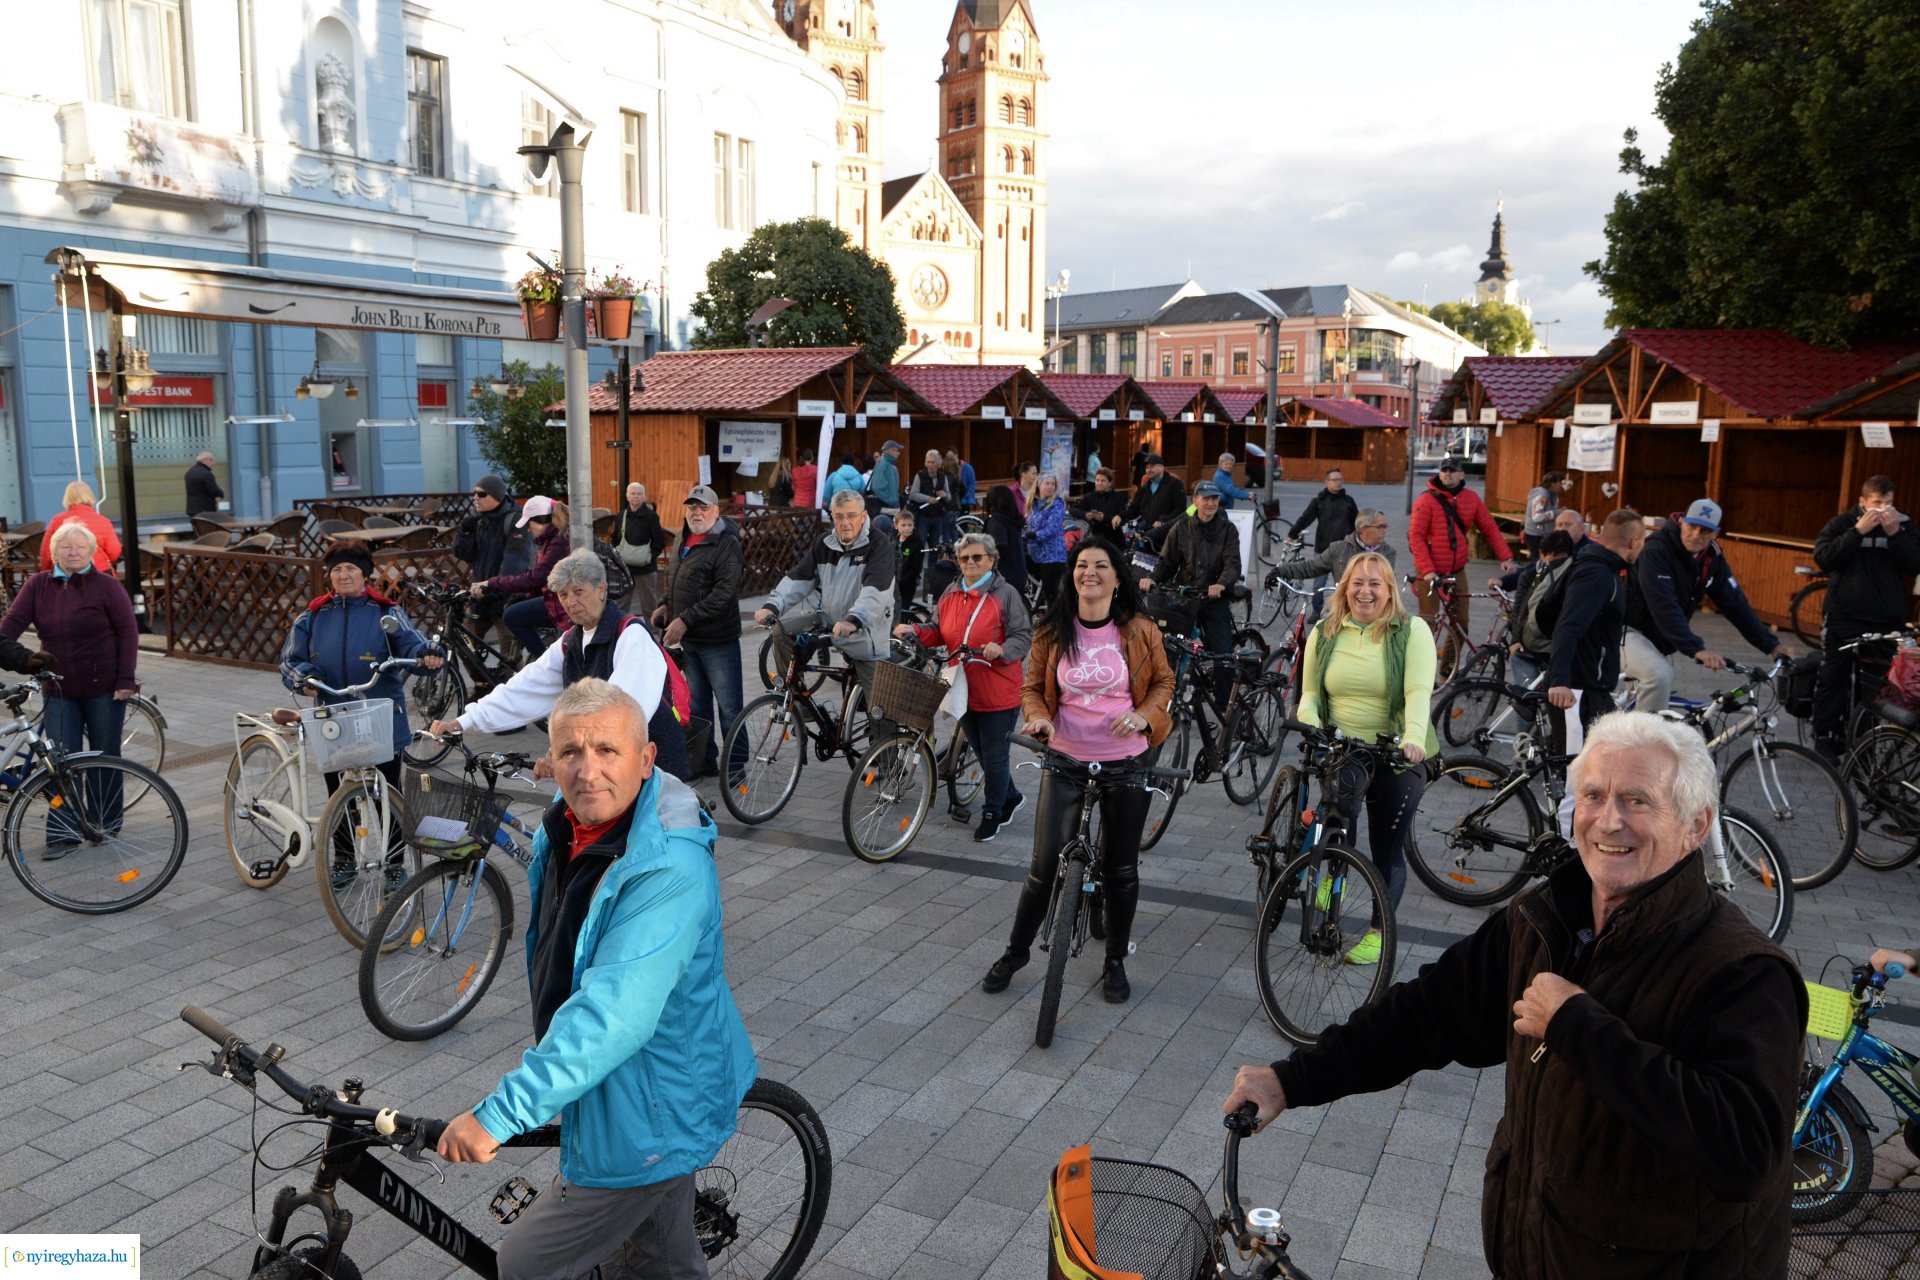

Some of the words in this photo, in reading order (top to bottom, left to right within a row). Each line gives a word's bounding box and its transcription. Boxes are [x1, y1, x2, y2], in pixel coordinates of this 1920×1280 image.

[351, 305, 386, 326] JOHN
[389, 308, 422, 329] BULL
[424, 312, 473, 333] KORONA
[476, 316, 500, 335] PUB
[165, 386, 192, 396] BANK
[380, 1171, 467, 1258] CANYON
